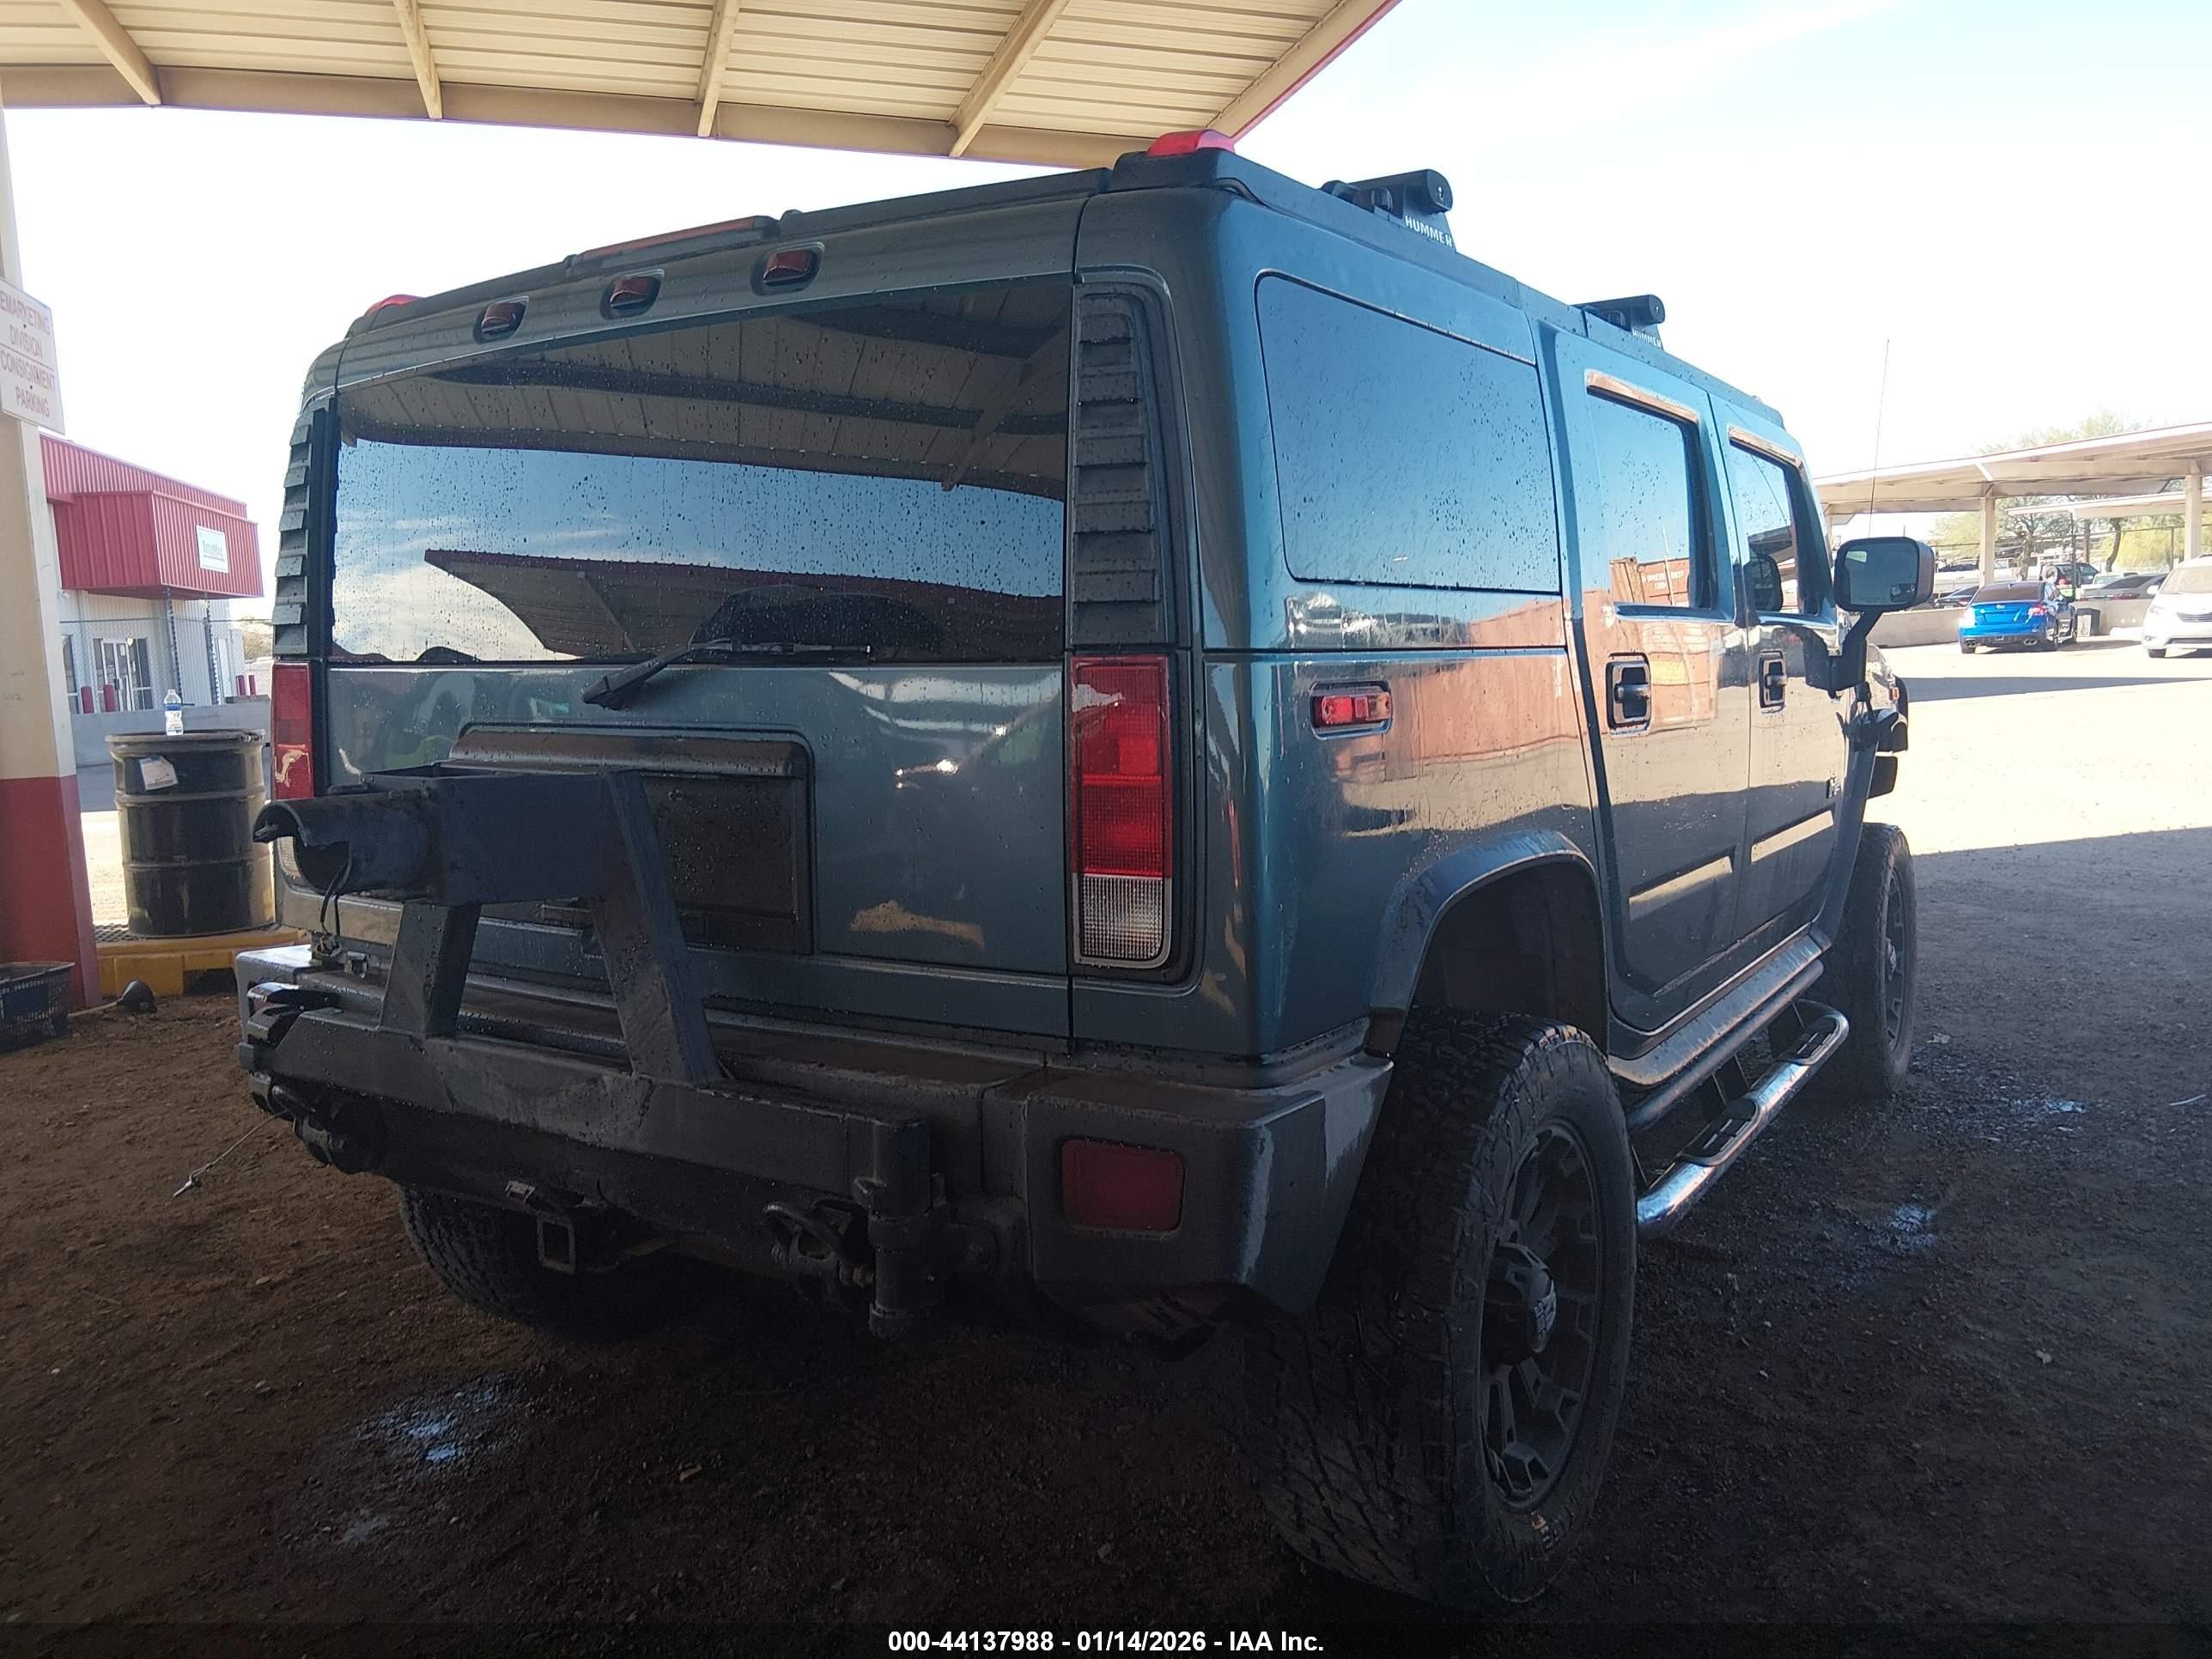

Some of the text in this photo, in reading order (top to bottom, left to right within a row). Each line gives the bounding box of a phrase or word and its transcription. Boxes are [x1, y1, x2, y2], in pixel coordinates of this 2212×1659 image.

[1405, 215, 1453, 247] HUMMER
[0, 289, 50, 336] EMARKETING
[9, 325, 43, 359] DIVISION
[1, 349, 56, 392] CONSIGNMENT
[15, 386, 50, 417] PARKING
